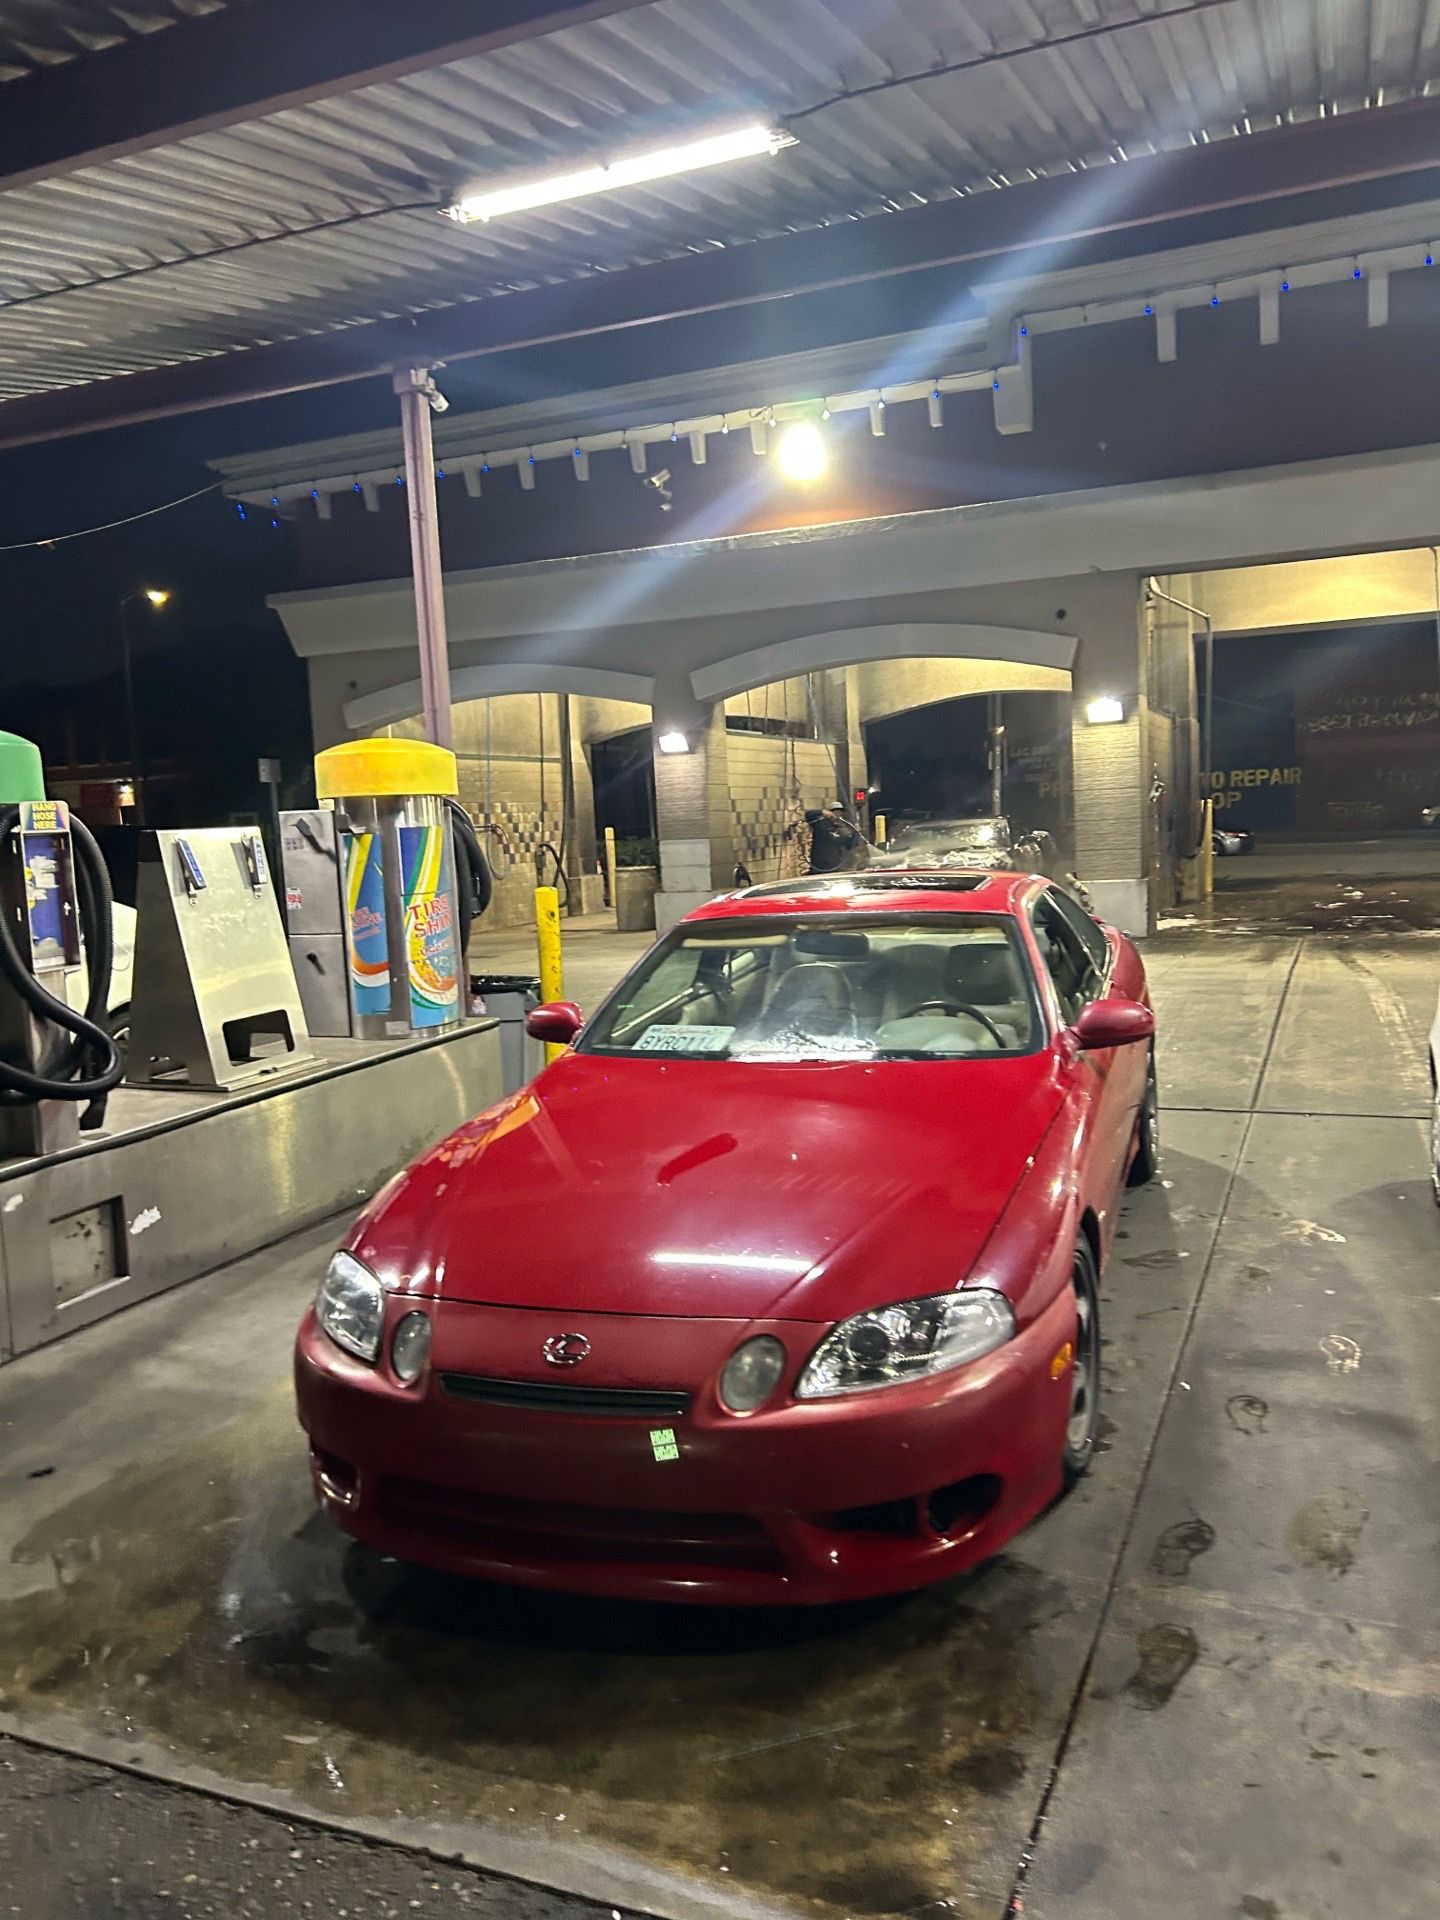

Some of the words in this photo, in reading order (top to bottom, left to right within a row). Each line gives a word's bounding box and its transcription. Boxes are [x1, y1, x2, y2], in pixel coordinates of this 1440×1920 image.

[1230, 767, 1303, 787] REPAIR
[32, 803, 57, 811] HANG
[32, 812, 57, 820] HOSE
[33, 820, 57, 830] HERE
[408, 893, 449, 920] TIRE
